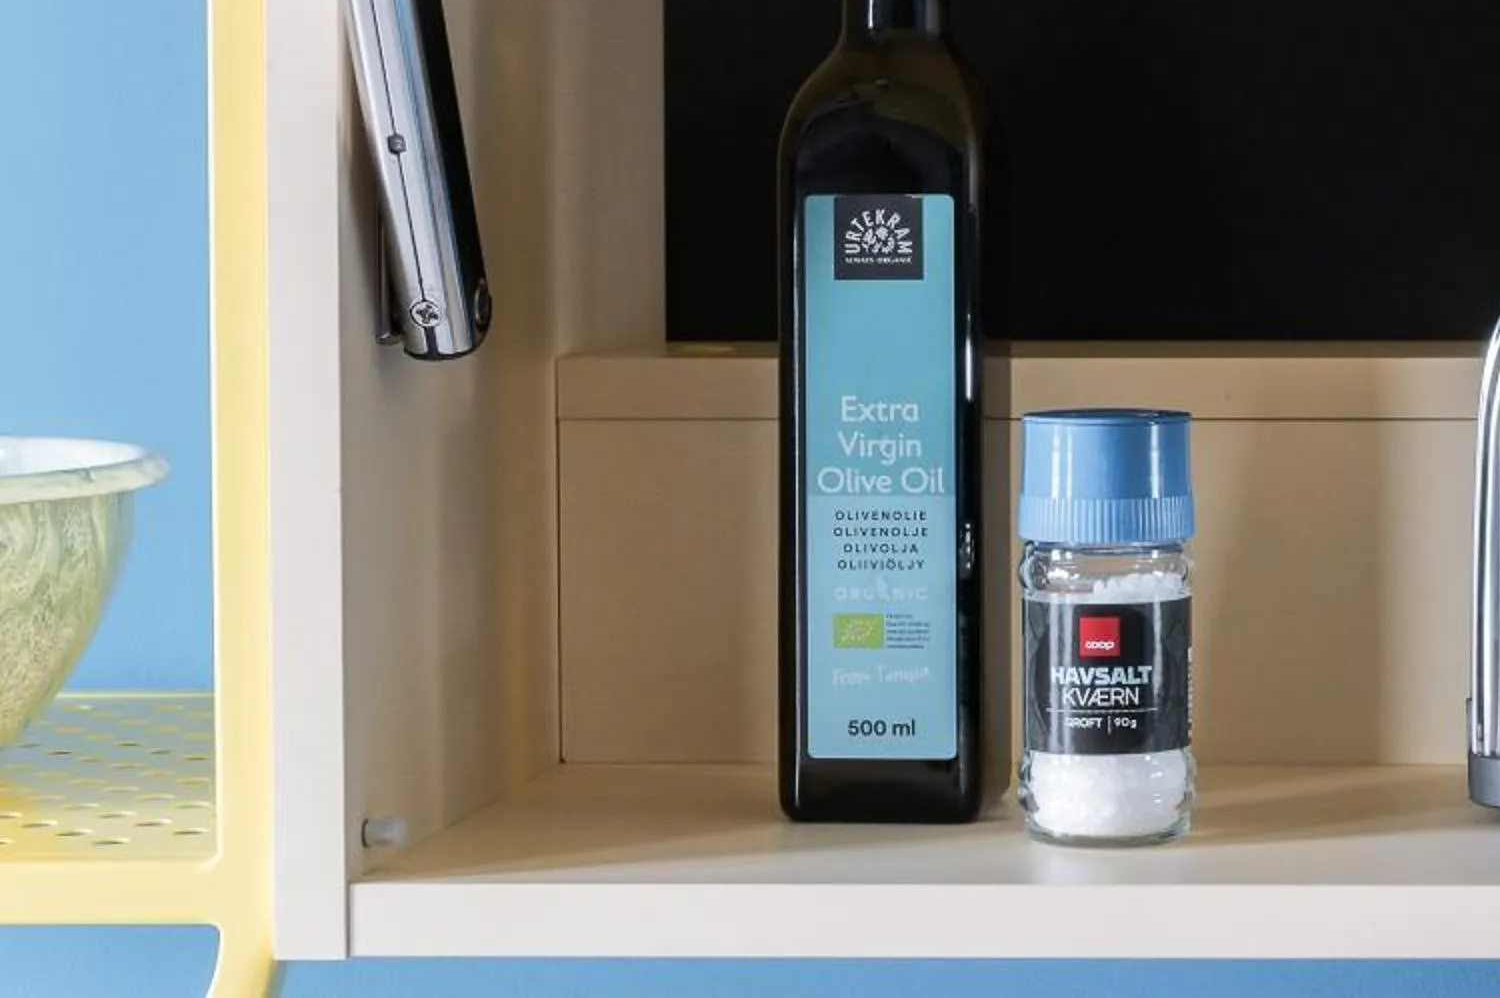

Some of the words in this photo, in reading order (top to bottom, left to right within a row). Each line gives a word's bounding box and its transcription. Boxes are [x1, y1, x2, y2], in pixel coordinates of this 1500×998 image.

[844, 209, 913, 254] URTEKRAM
[841, 395, 919, 422] Extra
[837, 431, 922, 465] Virgin
[817, 467, 892, 493] Olive
[901, 467, 945, 493] Oil
[834, 510, 927, 521] OLIVENOLIE
[833, 527, 928, 537] OLIVENOLJE
[843, 543, 919, 553] OLIVOLJA
[837, 558, 925, 570] OLIIVIÖLJY
[1085, 640, 1115, 650] coop
[1051, 666, 1152, 685] HAVSALT
[1062, 687, 1139, 706] KVÆRN
[848, 719, 886, 736] 500
[892, 718, 915, 736] ml
